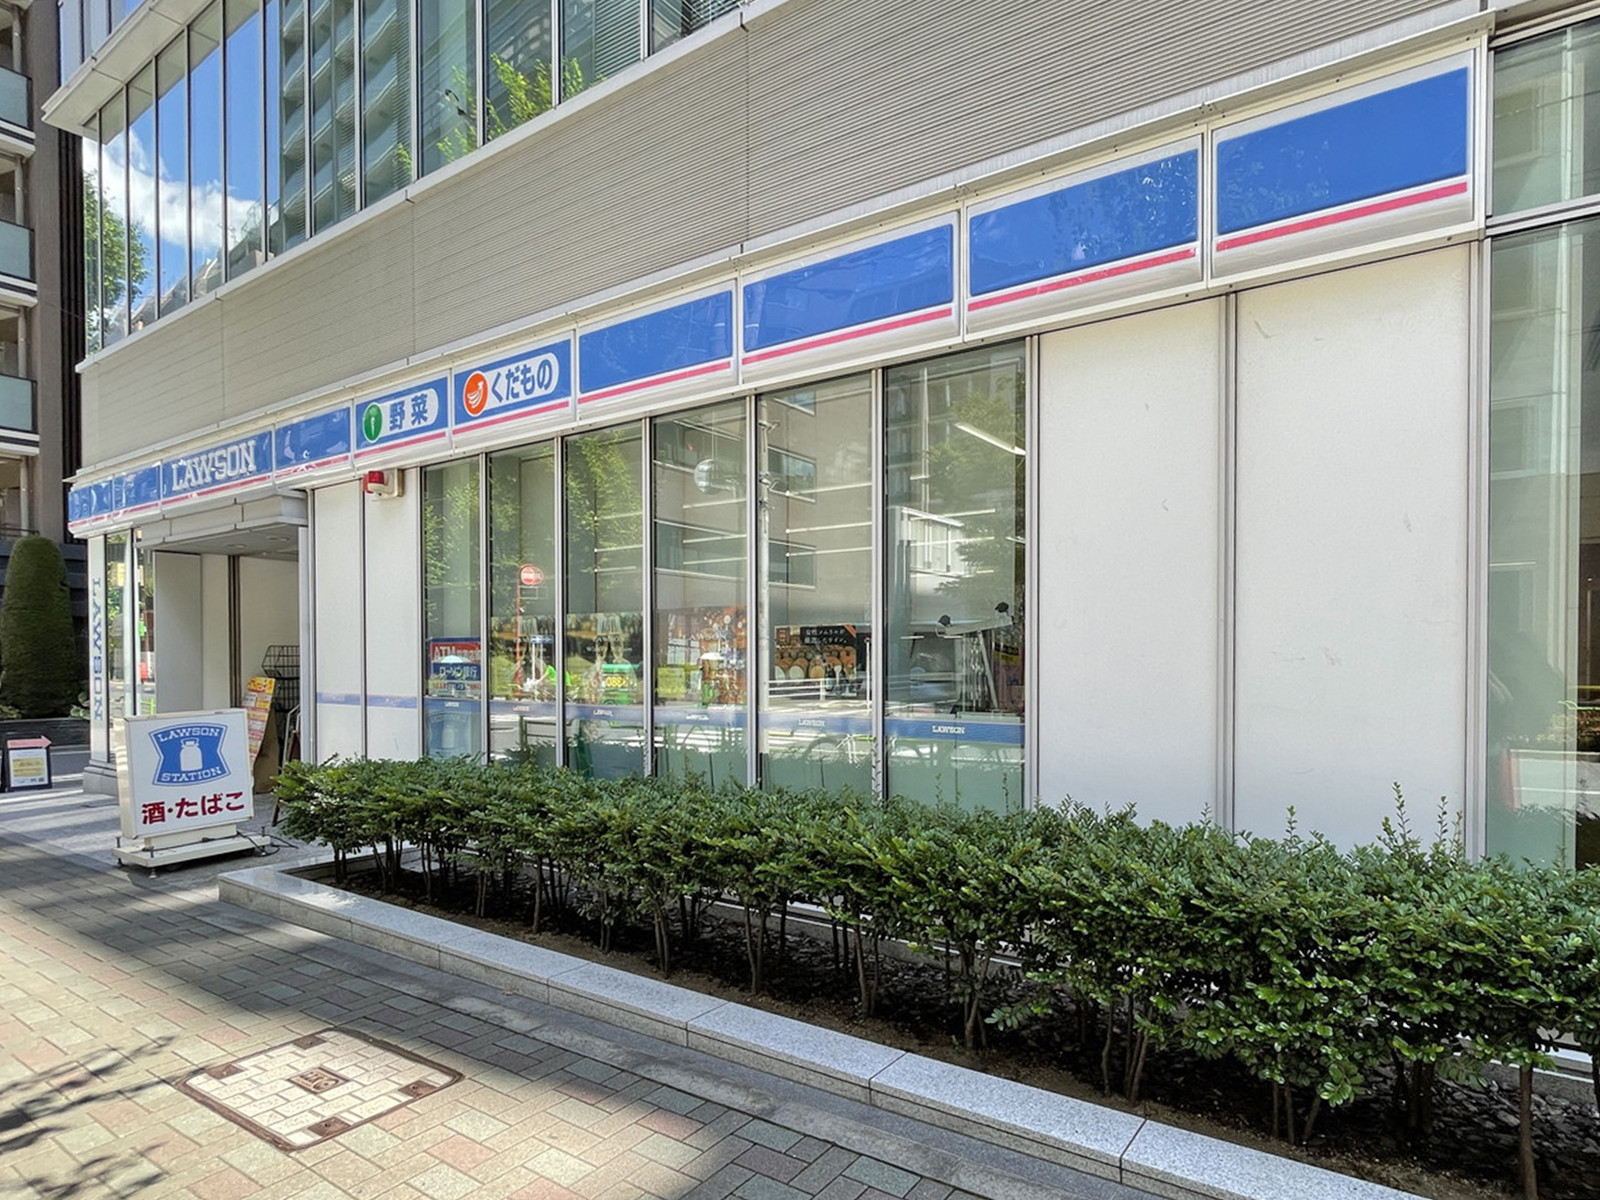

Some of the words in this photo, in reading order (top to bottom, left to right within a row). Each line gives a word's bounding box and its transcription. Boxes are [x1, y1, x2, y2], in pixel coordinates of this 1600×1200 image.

[491, 359, 552, 403] くだもの
[389, 393, 428, 431] 野菜
[171, 439, 257, 491] LAWSON
[92, 577, 103, 721] LAWSON
[158, 727, 220, 742] LAWSON
[932, 725, 965, 734] LAWSON
[161, 766, 222, 782] STATION
[141, 792, 245, 825] 酒・たばこ
